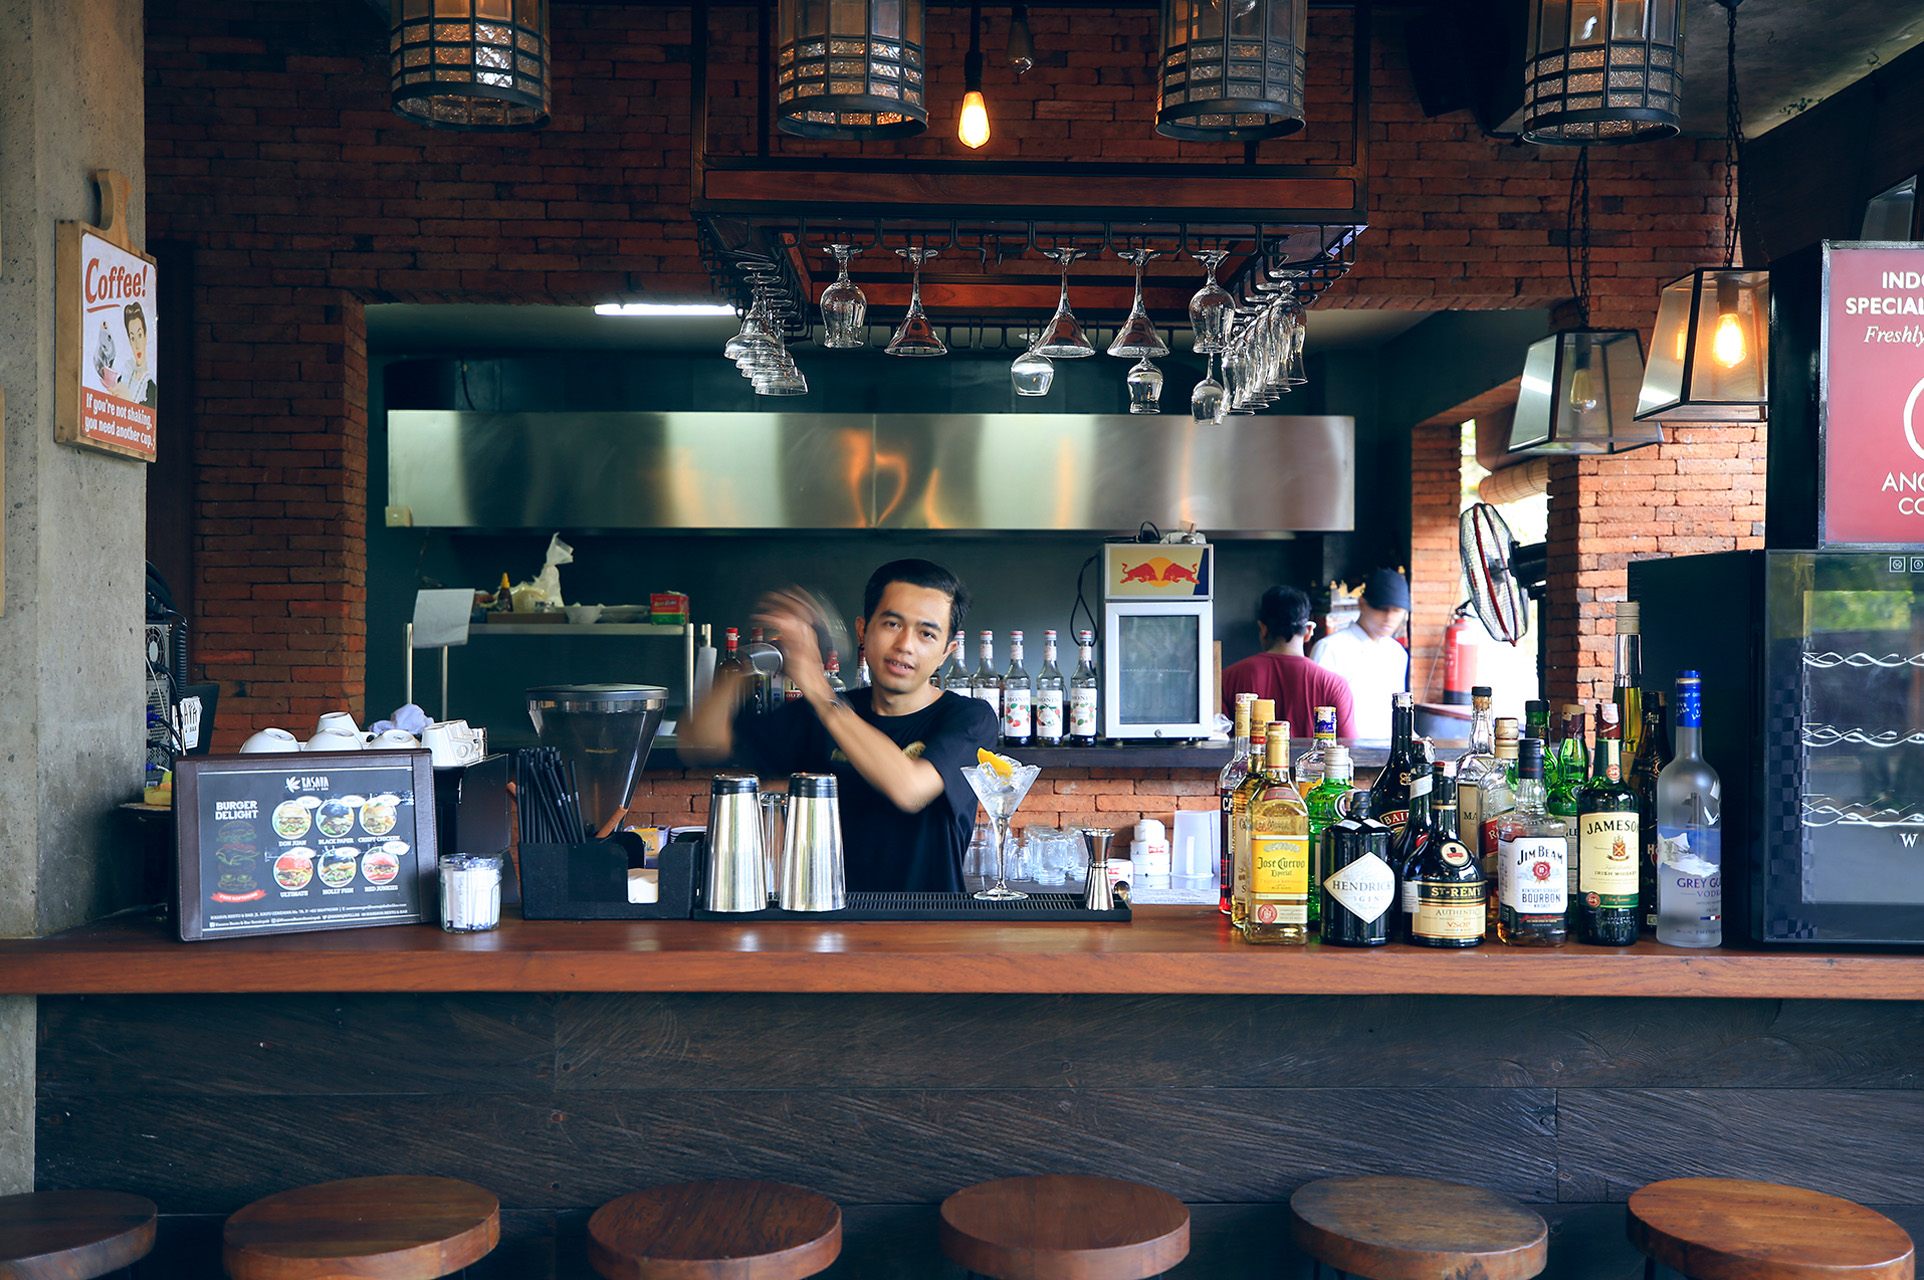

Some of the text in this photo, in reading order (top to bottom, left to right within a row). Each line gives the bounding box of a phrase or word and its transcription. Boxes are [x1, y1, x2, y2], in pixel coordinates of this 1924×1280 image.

[85, 258, 147, 304] Coffee!
[1882, 271, 1924, 289] IND
[1863, 324, 1924, 348] Freshly
[86, 392, 93, 408] If
[93, 398, 116, 415] you're
[116, 405, 127, 419] not
[84, 416, 98, 432] you
[98, 420, 116, 435] need
[116, 426, 140, 442] another
[216, 800, 257, 811] BURGER
[215, 810, 259, 820] DELIGHT
[1586, 820, 1638, 835] JAMESO
[1517, 845, 1563, 866] JIM BEAM
[1676, 877, 1707, 889] GREY
[1522, 893, 1561, 903] BOURBON
